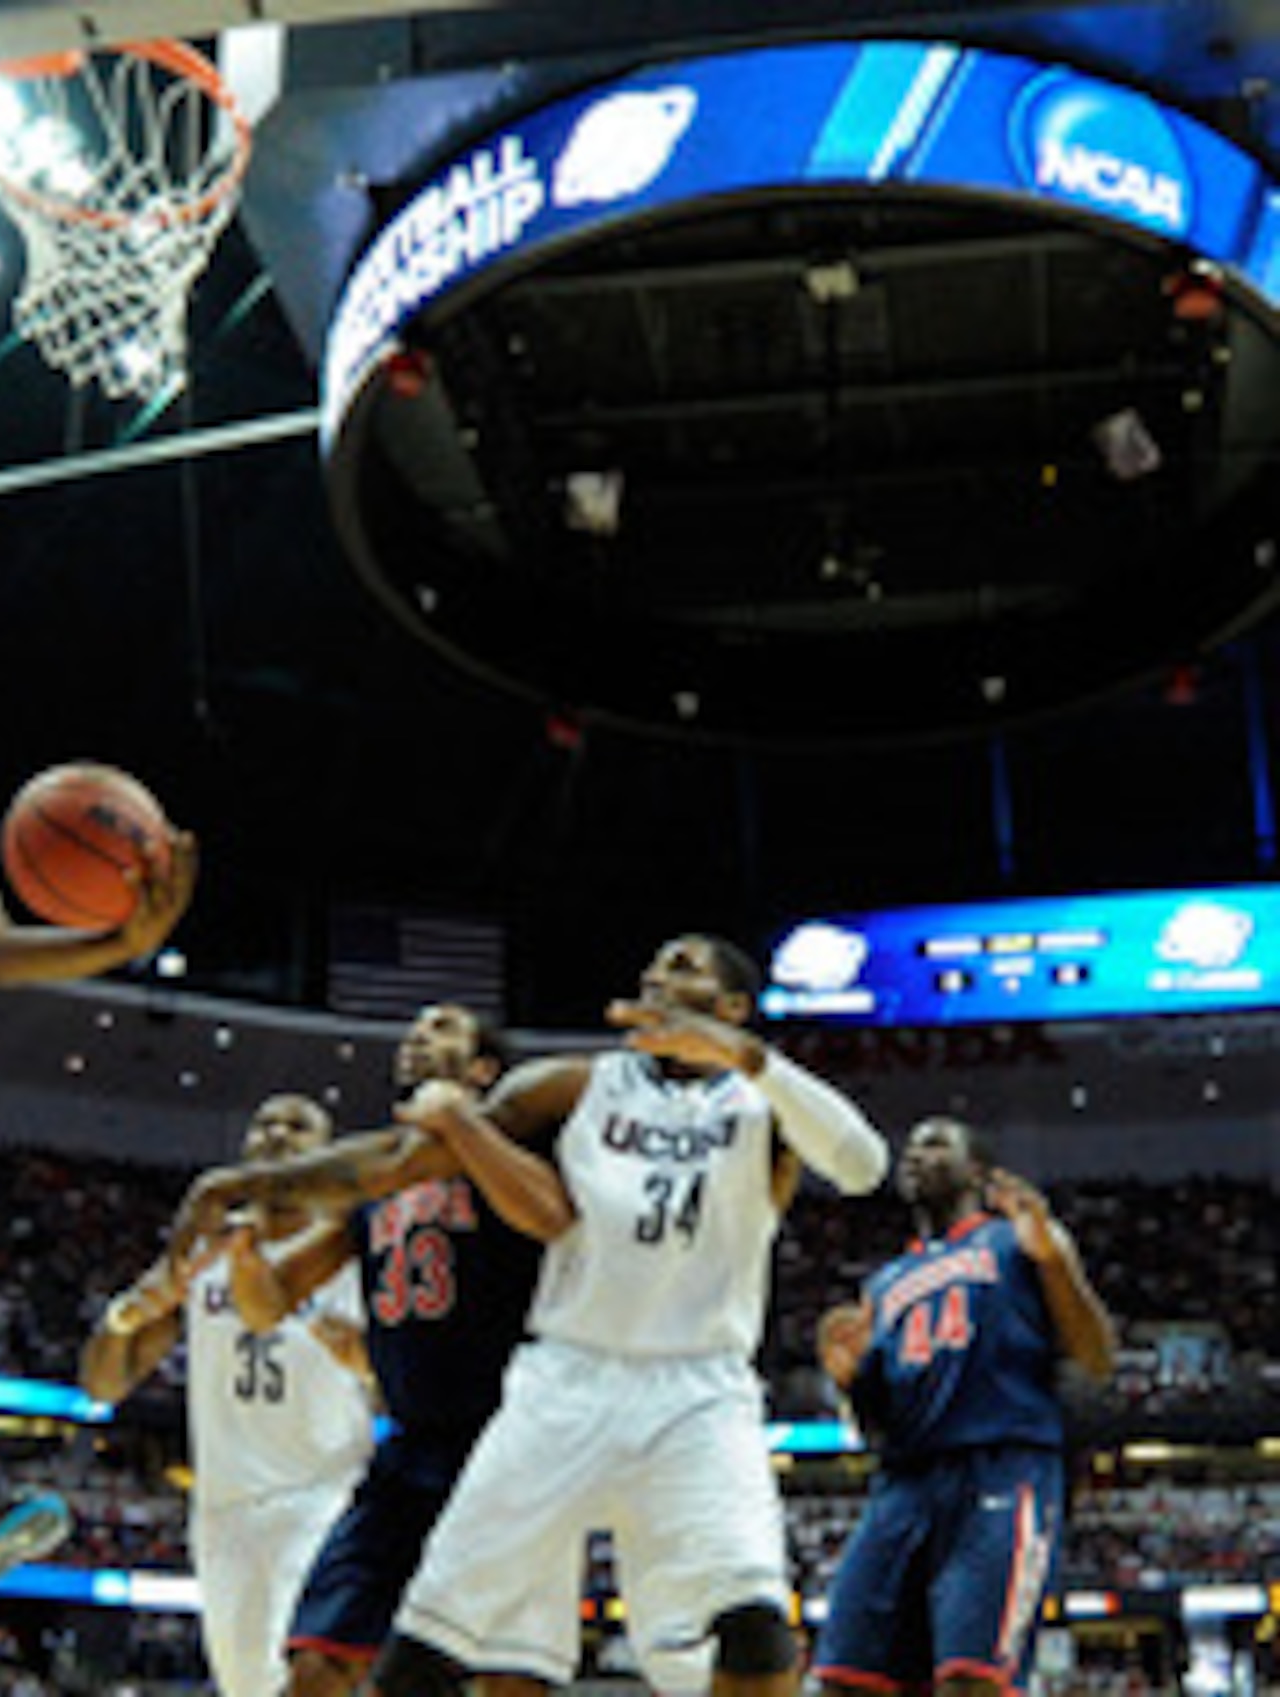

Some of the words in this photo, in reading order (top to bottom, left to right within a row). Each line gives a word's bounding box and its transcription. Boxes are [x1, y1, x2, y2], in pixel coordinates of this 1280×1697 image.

[1037, 143, 1182, 228] NCAA
[636, 1172, 706, 1248] 34
[373, 1228, 458, 1326] 33
[898, 1285, 972, 1366] 44
[235, 1330, 285, 1403] 35
